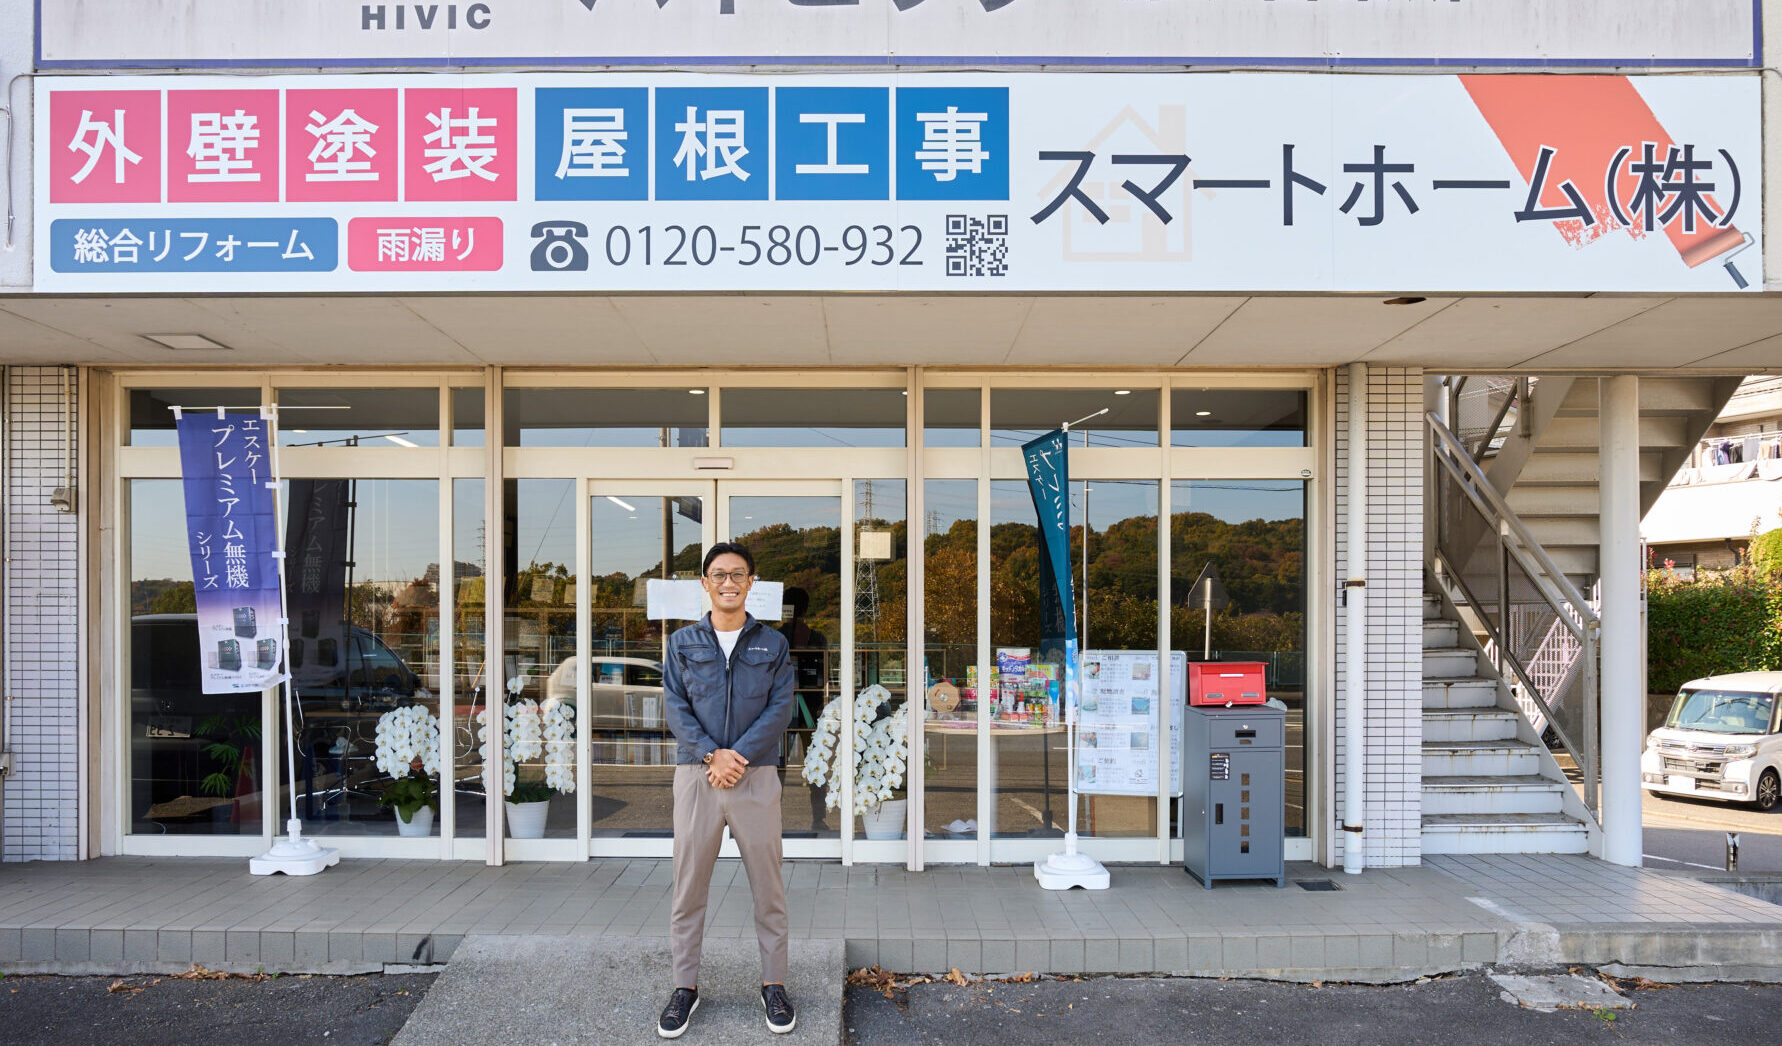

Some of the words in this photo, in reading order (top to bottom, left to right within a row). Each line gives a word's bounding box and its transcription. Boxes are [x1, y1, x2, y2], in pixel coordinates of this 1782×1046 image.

[362, 4, 491, 30] HIVIC
[68, 107, 499, 185] 外壁塗装
[554, 106, 990, 182] 屋根工事
[73, 228, 315, 264] 総合リフォーム
[376, 226, 475, 262] 雨漏り
[605, 224, 924, 266] 0120-580-932
[242, 418, 262, 485] エスケー
[211, 424, 250, 589] プレミアム無機
[196, 531, 218, 589] シリーズ
